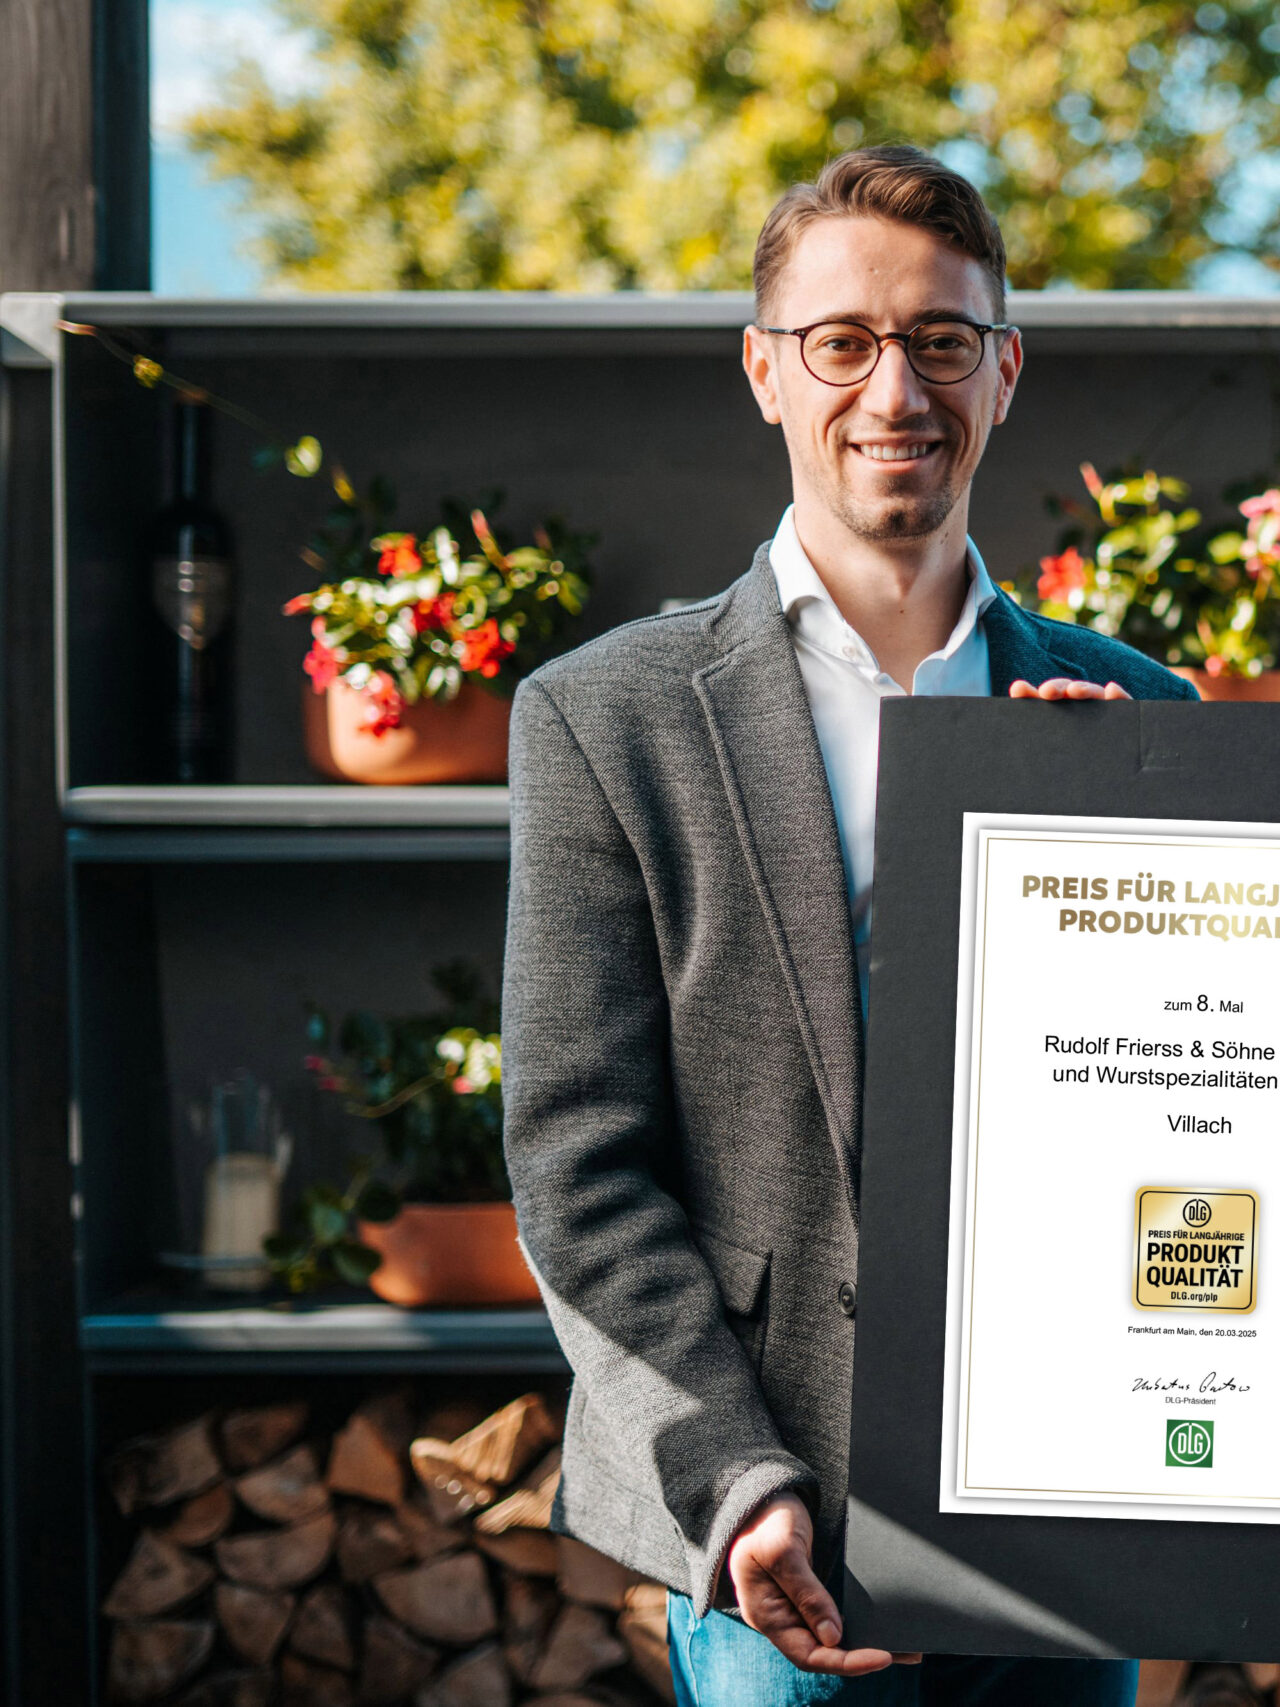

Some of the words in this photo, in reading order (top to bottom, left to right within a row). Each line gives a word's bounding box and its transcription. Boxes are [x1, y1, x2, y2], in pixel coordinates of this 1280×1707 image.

[1023, 875, 1108, 900] PREIS
[1117, 872, 1175, 902] FÜR
[1164, 1001, 1192, 1011] zum
[1197, 994, 1214, 1012] 8.
[1220, 1000, 1243, 1013] Mal
[1045, 1035, 1110, 1055] Rudolf
[1116, 1038, 1183, 1057] Frierss
[1191, 1040, 1204, 1058] &
[1212, 1041, 1275, 1060] Söhne
[1053, 1066, 1089, 1083] und
[1096, 1066, 1278, 1090] Wurstspezialitäten
[1167, 1115, 1231, 1134] Villach
[1189, 1199, 1207, 1221] DLG
[1148, 1230, 1171, 1239] PREIS
[1172, 1230, 1188, 1239] FÜR
[1189, 1230, 1244, 1241] LANGJÄHRIGE
[1147, 1242, 1244, 1265] PRODUKT
[1146, 1265, 1243, 1288] QUALITÄT
[1171, 1291, 1218, 1303] DLG.org/plp
[1128, 1326, 1161, 1334] Frankfurt
[1177, 1328, 1197, 1336] Main,
[1215, 1329, 1257, 1337] 20.03.2025
[1178, 1425, 1203, 1454] DLG
